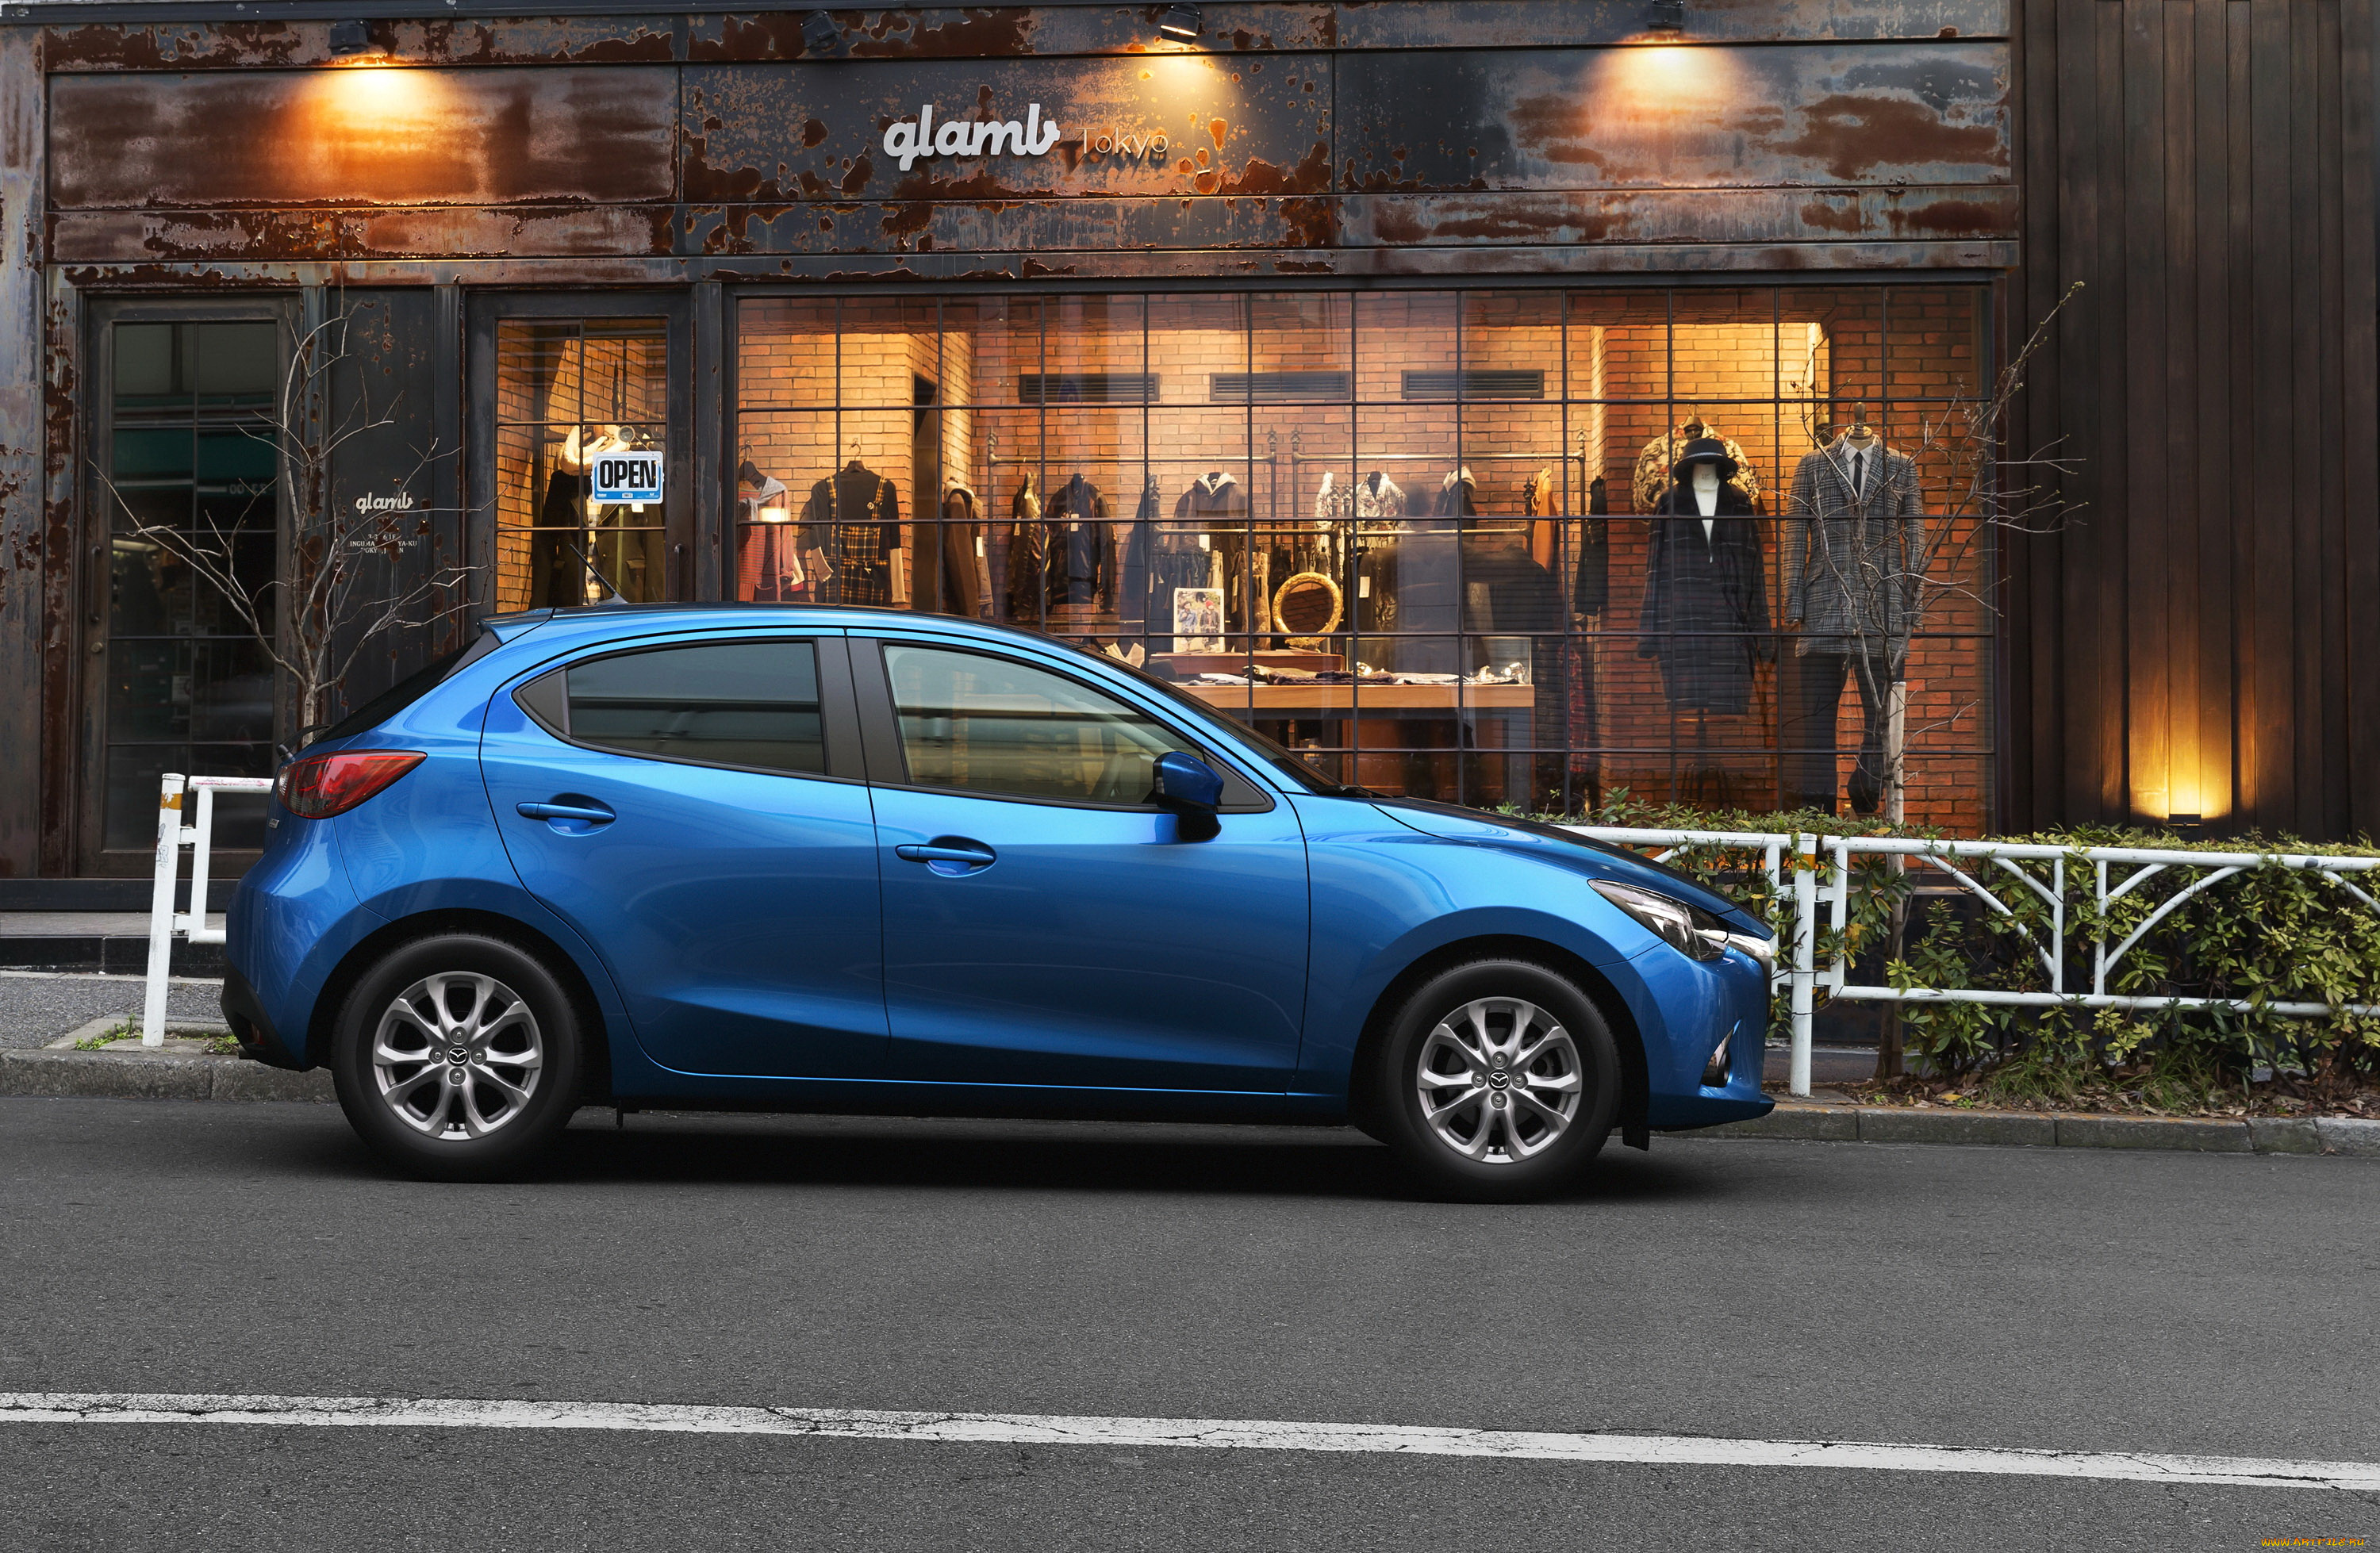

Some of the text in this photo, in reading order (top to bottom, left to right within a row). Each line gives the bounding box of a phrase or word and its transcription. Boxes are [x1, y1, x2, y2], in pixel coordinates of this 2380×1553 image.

[883, 103, 1169, 171] glamb Tokyo
[600, 460, 656, 488] OPEN
[355, 492, 413, 515] glamb
